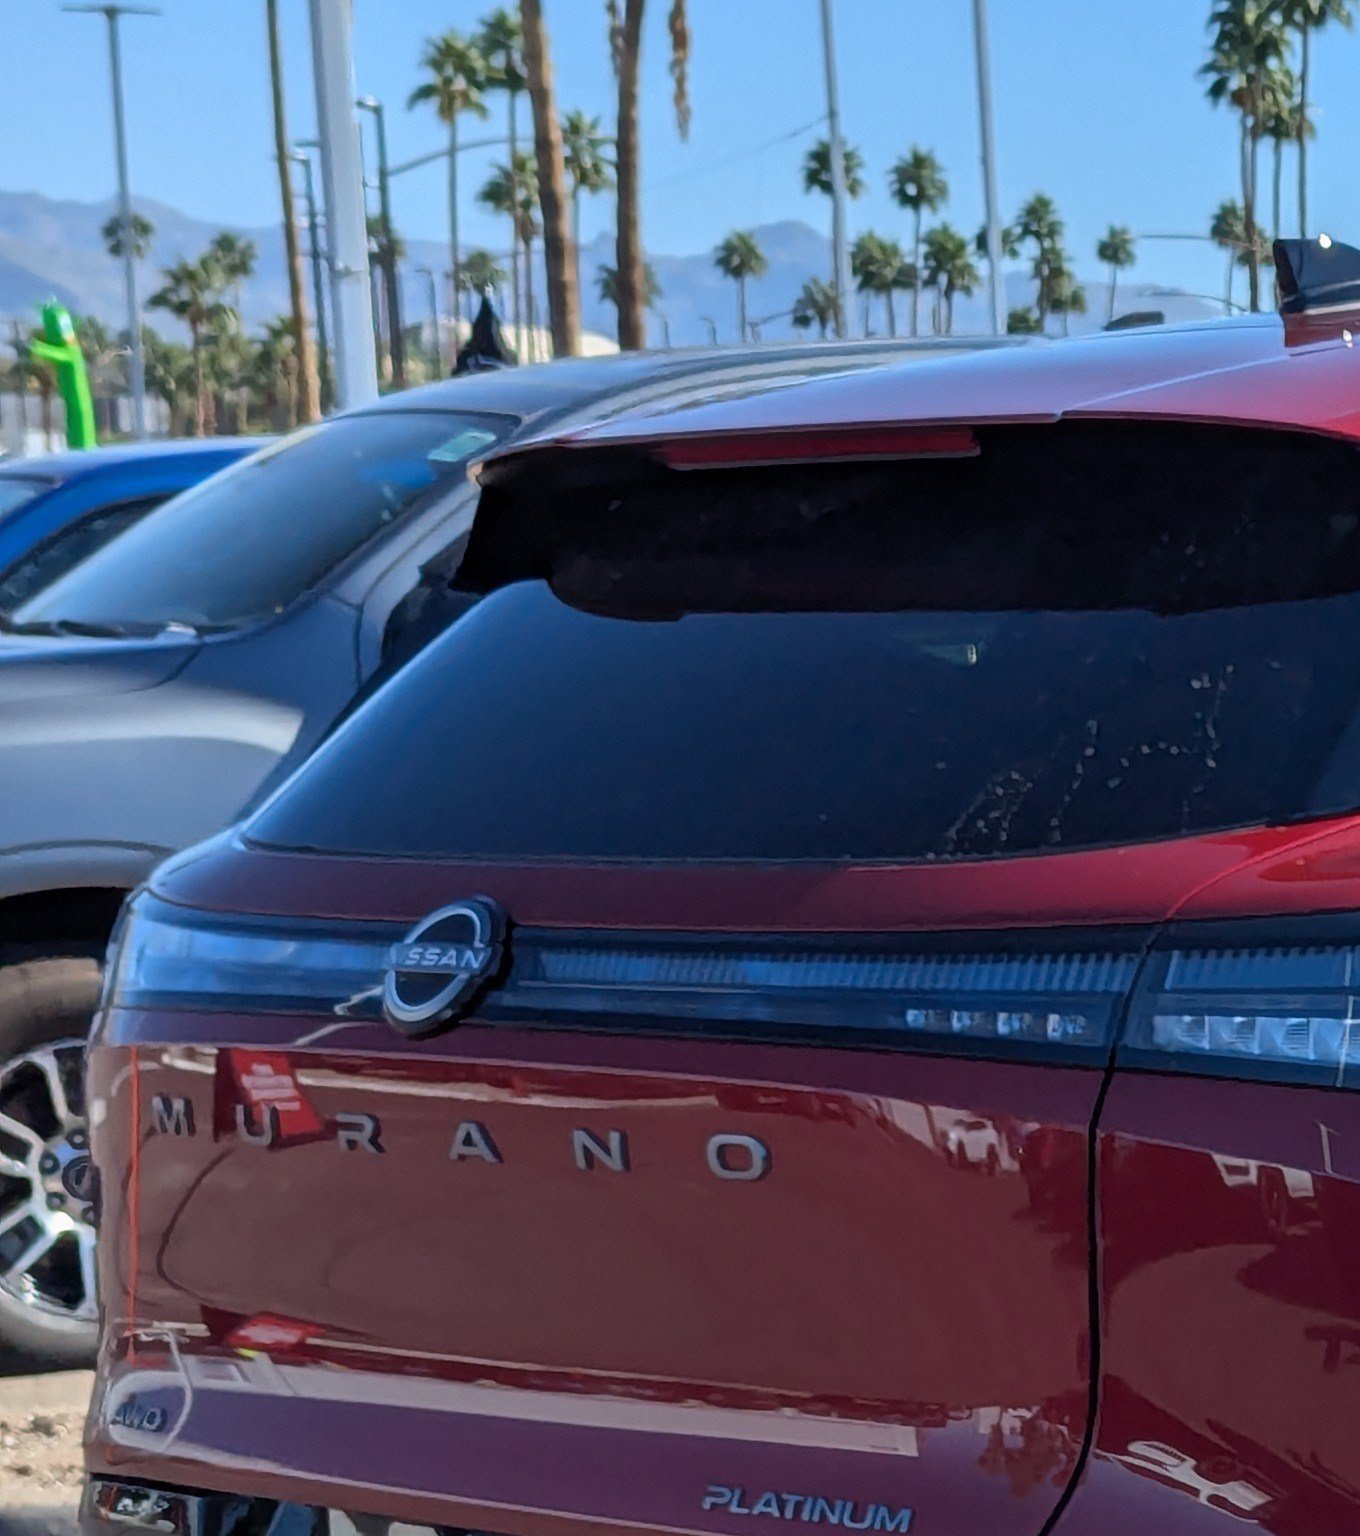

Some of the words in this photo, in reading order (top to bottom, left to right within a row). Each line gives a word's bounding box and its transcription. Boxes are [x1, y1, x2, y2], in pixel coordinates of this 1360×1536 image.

[388, 946, 486, 970] SSAN
[152, 1094, 771, 1181] MURANO
[702, 1484, 912, 1533] PLATINUM
